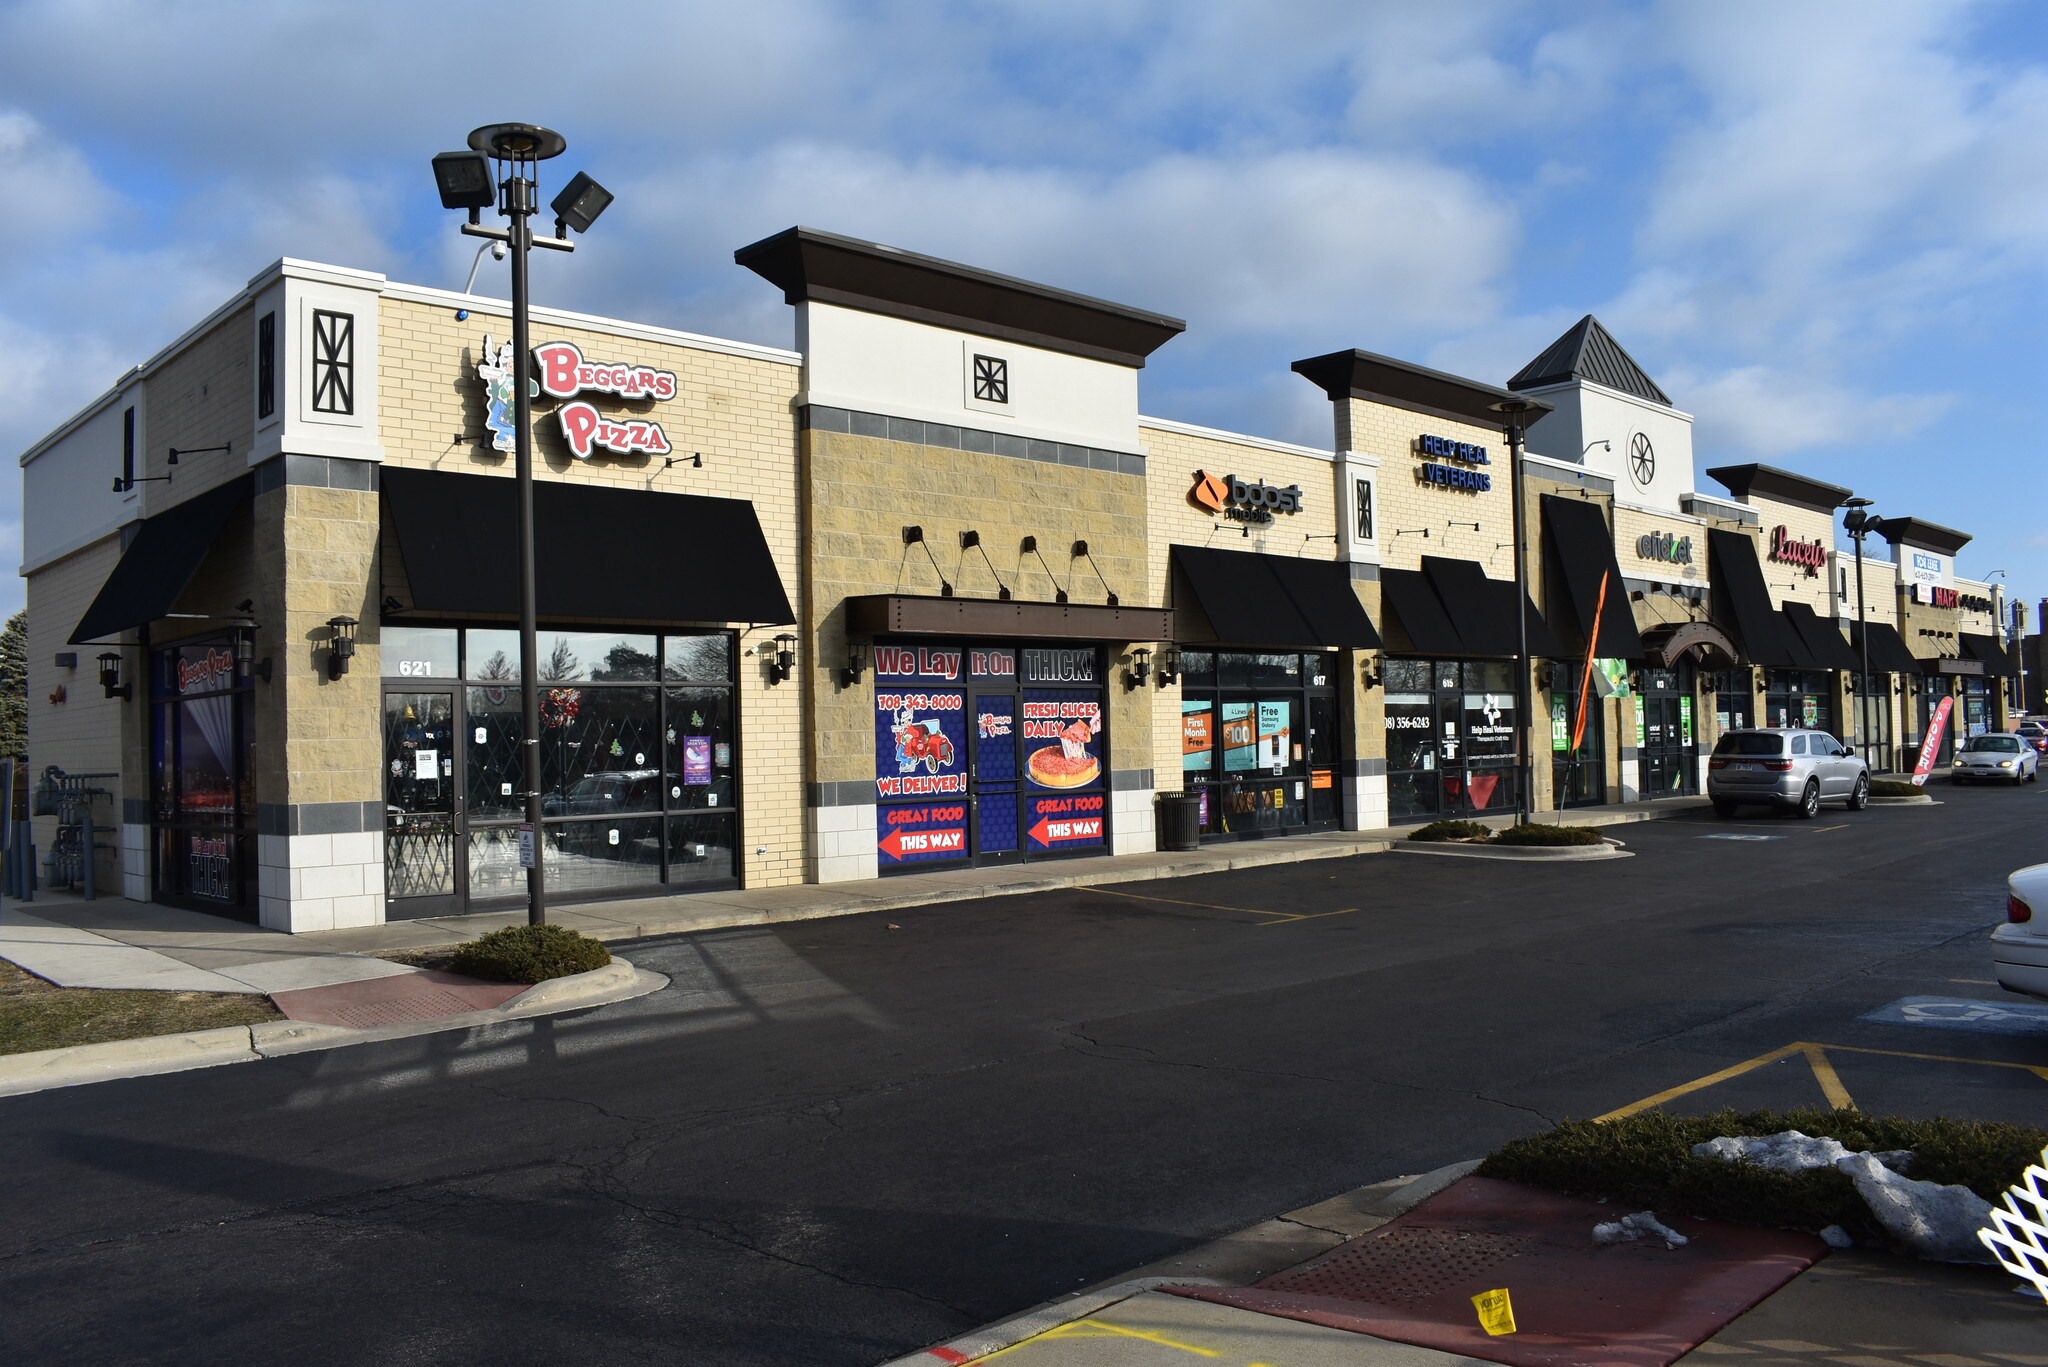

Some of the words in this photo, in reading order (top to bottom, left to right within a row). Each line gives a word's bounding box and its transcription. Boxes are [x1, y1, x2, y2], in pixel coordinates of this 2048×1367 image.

[538, 346, 673, 396] BEGGARS
[563, 405, 667, 454] PIZZA
[1422, 434, 1456, 457] HELP
[1459, 442, 1491, 465] HEAL
[1425, 463, 1491, 492] VETERANS
[1229, 474, 1303, 512] boost
[1224, 507, 1273, 523] mobile
[1638, 530, 1693, 564] cricket
[207, 648, 233, 685] PIZZA
[399, 660, 431, 676] 621
[875, 647, 915, 675] We
[918, 648, 961, 680] Lay
[971, 652, 987, 675] It
[989, 652, 1014, 676] On
[1025, 649, 1093, 681] THICK!
[1313, 675, 1326, 686] 617
[1442, 679, 1454, 688] 615
[877, 694, 962, 710] 708-343-8000
[1023, 702, 1060, 718] FRESH
[1060, 702, 1098, 719] SLICES
[1261, 706, 1279, 716] Free
[1552, 704, 1566, 720] 4G
[988, 724, 1010, 738] PIZZA
[1023, 719, 1065, 738] DAILY
[1187, 718, 1204, 727] First
[1396, 716, 1430, 729] 356-6243
[1552, 721, 1567, 740] LTE
[1184, 728, 1207, 737] Month
[1188, 737, 1205, 747] Free
[1225, 725, 1251, 744] $100
[876, 776, 901, 797] WE
[1036, 799, 1072, 814] GREAT
[1074, 796, 1104, 811] FOOD
[887, 808, 928, 825] GREAT
[931, 806, 964, 822] FOOD
[1047, 823, 1071, 838] THIS
[1071, 821, 1099, 836] WAY
[900, 834, 928, 851] THIS
[929, 832, 961, 849] WAY
